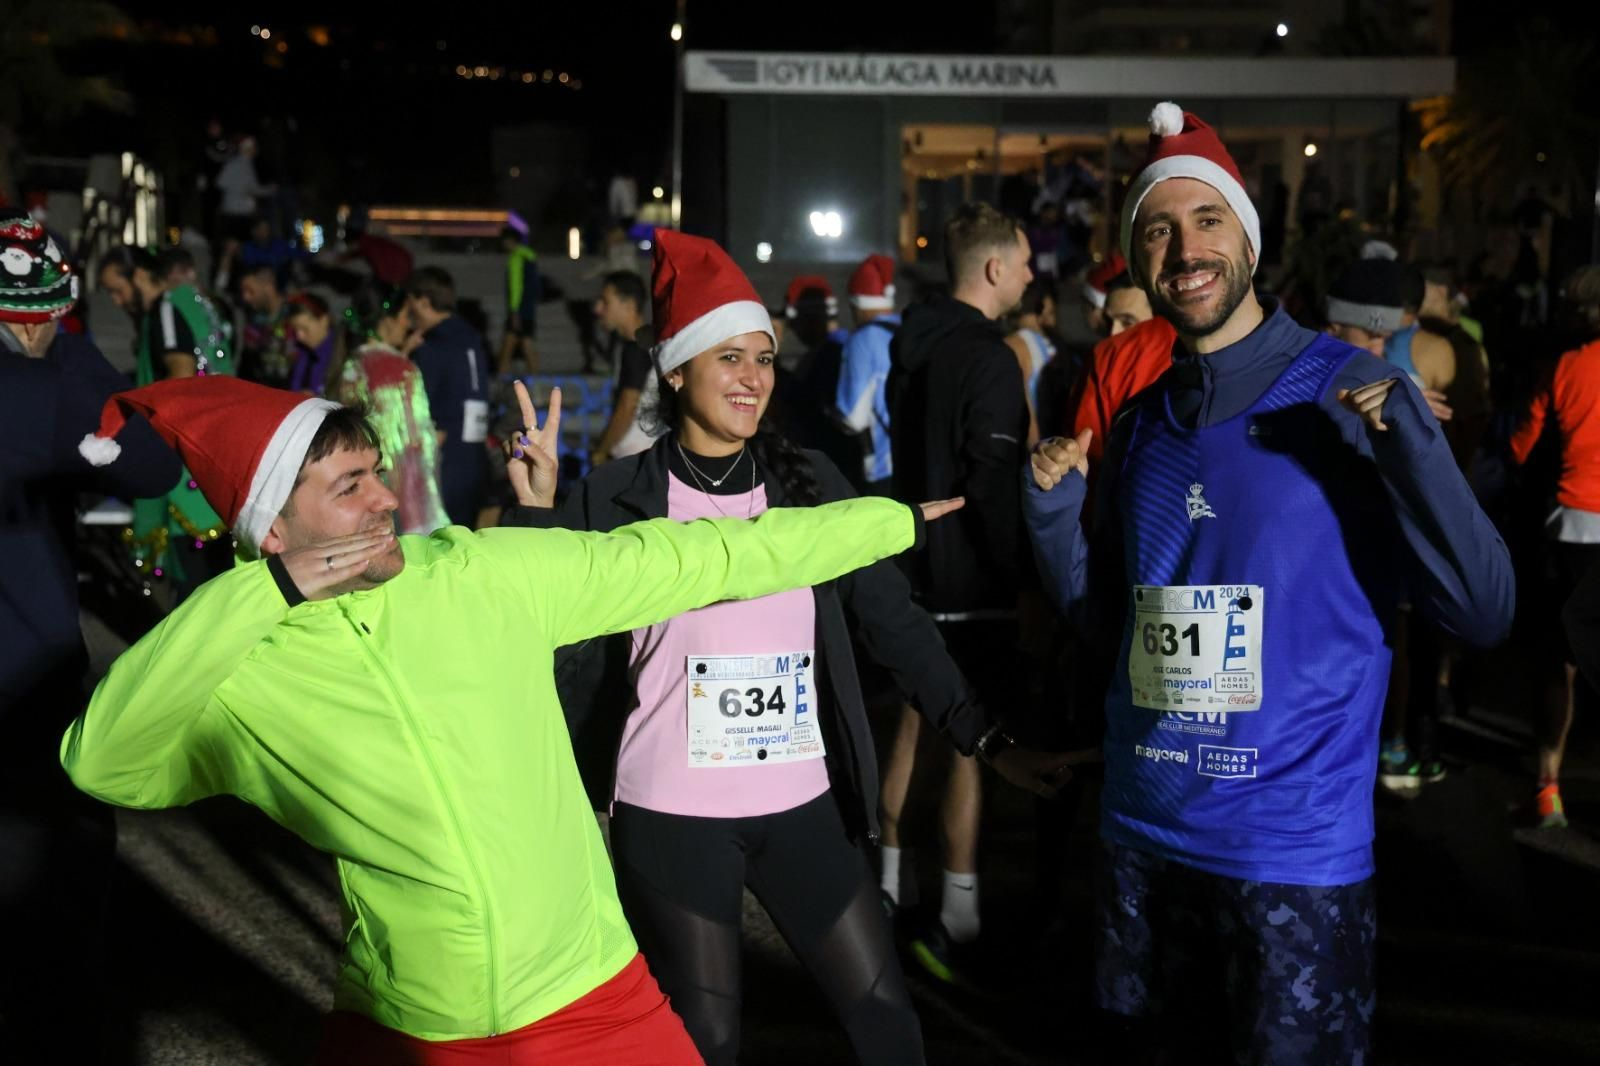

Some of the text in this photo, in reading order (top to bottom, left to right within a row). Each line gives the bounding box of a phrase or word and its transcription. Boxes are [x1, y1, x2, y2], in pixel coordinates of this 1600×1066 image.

[826, 54, 941, 86] MÁLAGA
[950, 62, 1060, 88] MARINA
[1143, 622, 1200, 657] 631
[1166, 666, 1192, 675] CARLOS
[1163, 678, 1212, 691] mayoral
[718, 684, 786, 718] 634
[757, 724, 782, 732] MAGALI
[747, 732, 789, 747] mayoral
[1135, 745, 1188, 763] mayoral
[1207, 752, 1247, 762] AEDAS
[1206, 762, 1246, 772] HOMES
